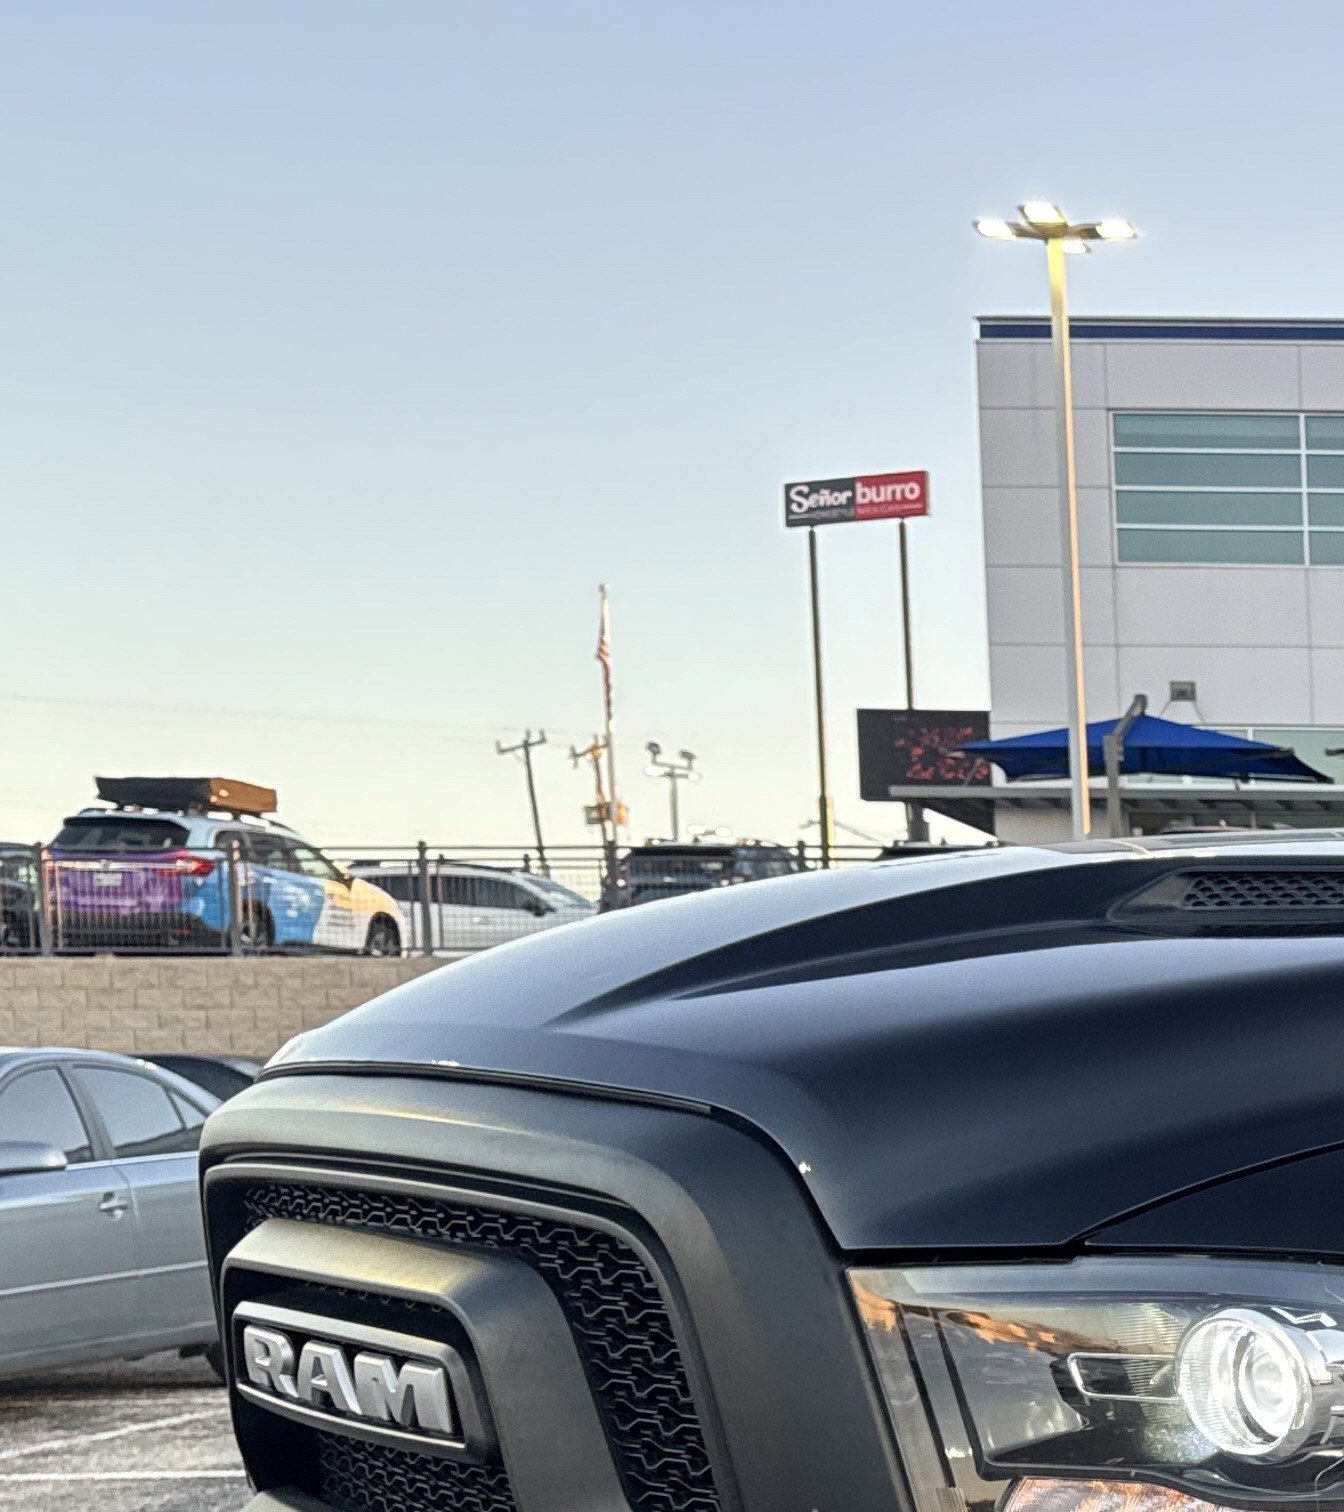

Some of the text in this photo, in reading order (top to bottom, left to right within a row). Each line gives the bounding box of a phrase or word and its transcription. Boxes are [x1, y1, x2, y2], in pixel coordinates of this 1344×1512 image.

[789, 484, 853, 514] Señor
[855, 481, 922, 505] burro
[243, 1323, 453, 1435] RAM
